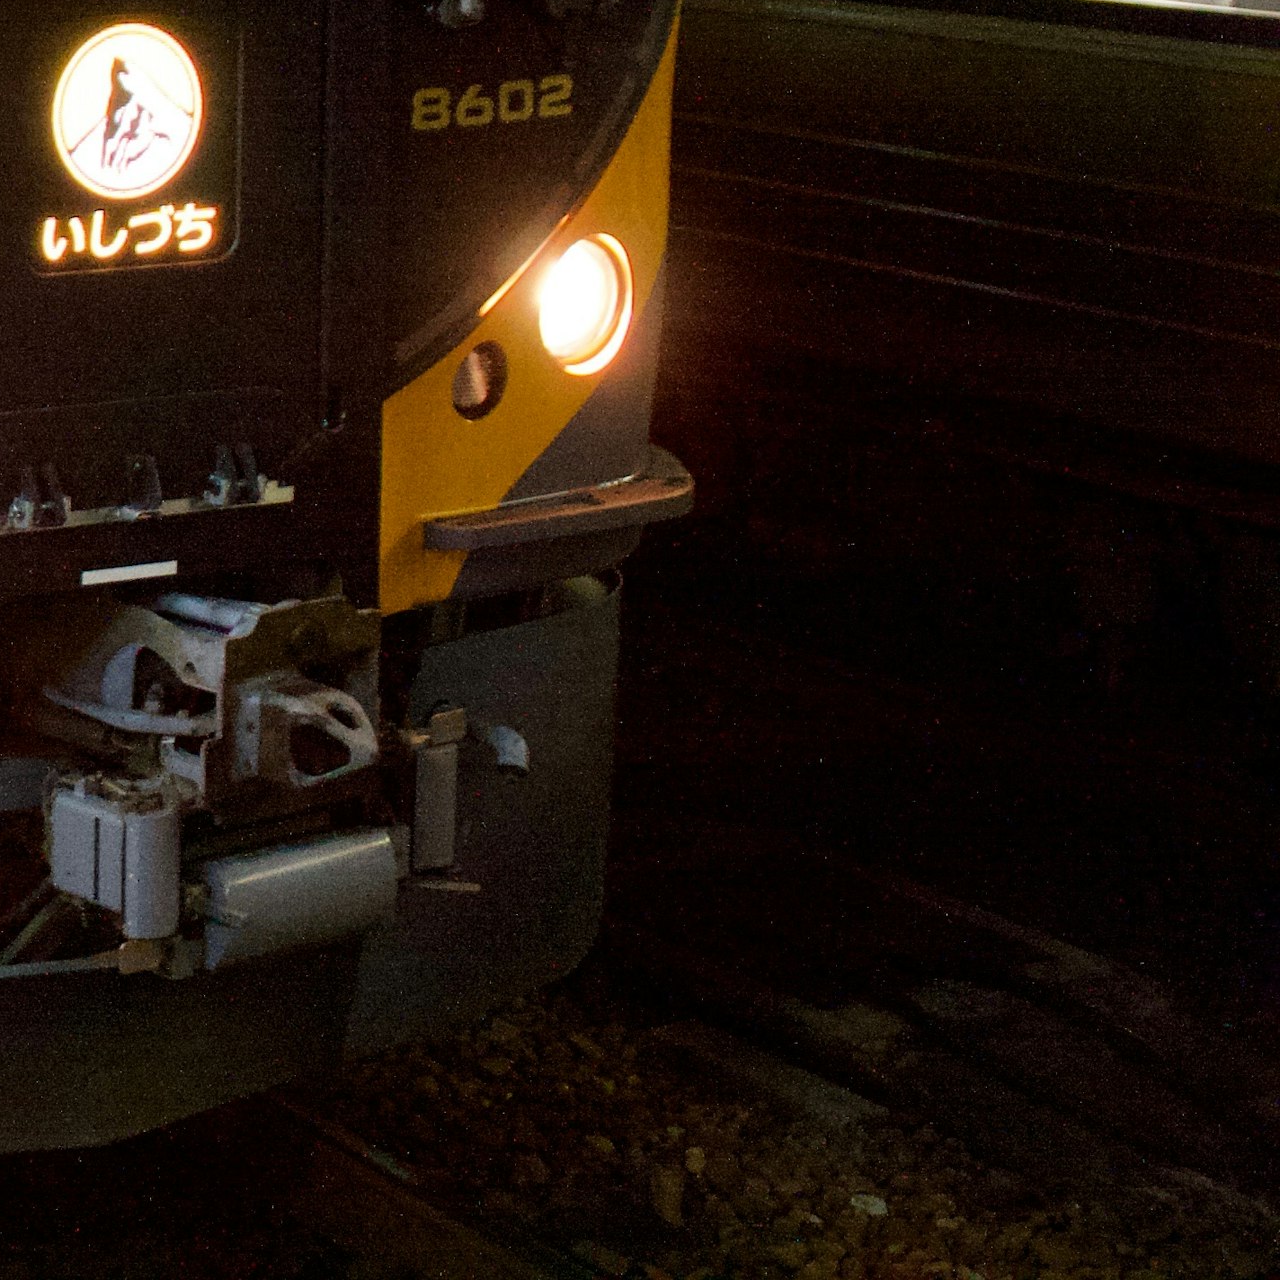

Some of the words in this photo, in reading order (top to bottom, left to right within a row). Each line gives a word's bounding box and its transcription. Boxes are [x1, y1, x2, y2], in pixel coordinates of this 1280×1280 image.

[411, 73, 574, 131] 8602
[41, 202, 217, 261] いしづち
